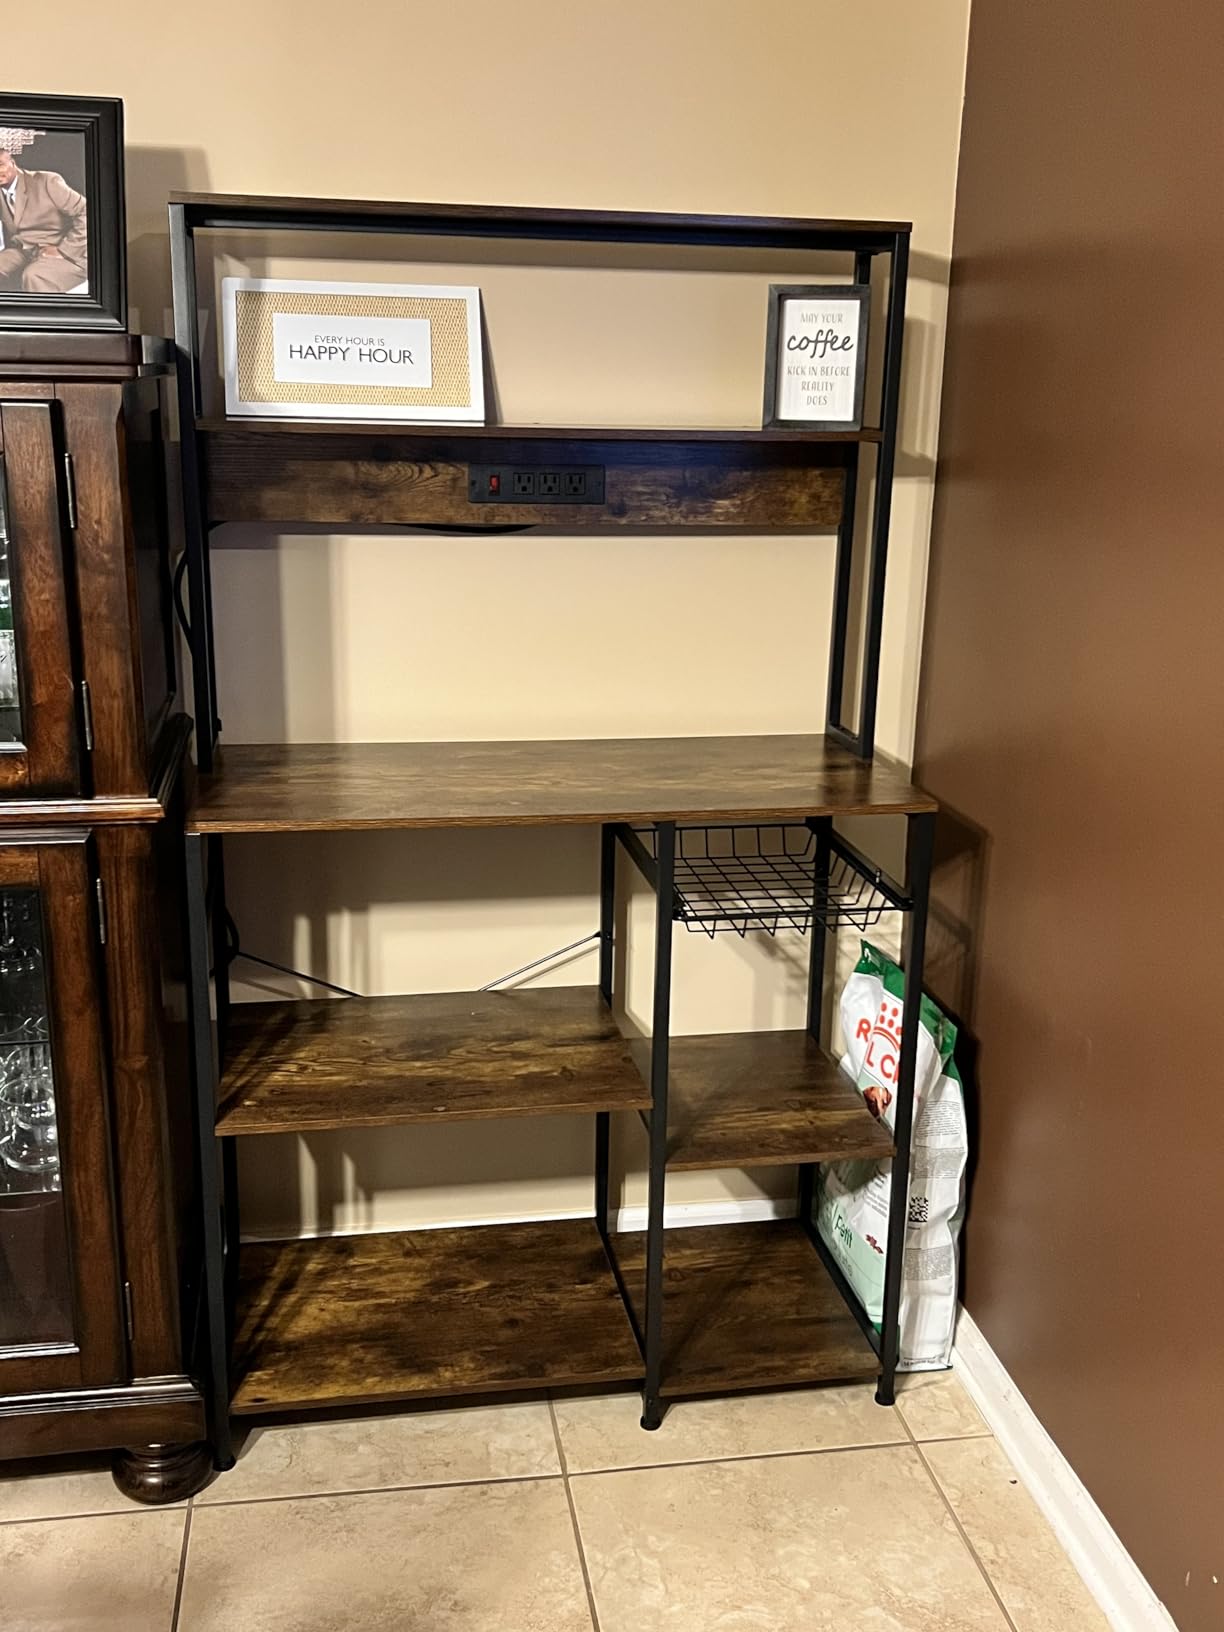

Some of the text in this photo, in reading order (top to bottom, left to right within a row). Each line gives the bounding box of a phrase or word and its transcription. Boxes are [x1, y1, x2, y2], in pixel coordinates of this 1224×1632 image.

[800, 312, 844, 323] MAY YOUR
[314, 334, 385, 347] EVERY HOUR IS
[787, 328, 854, 359] coffee
[289, 344, 414, 365] HAPPY HOUR
[786, 365, 851, 377] KICK IN BEFORE
[801, 381, 834, 391] REALITY
[806, 395, 828, 406] DOES
